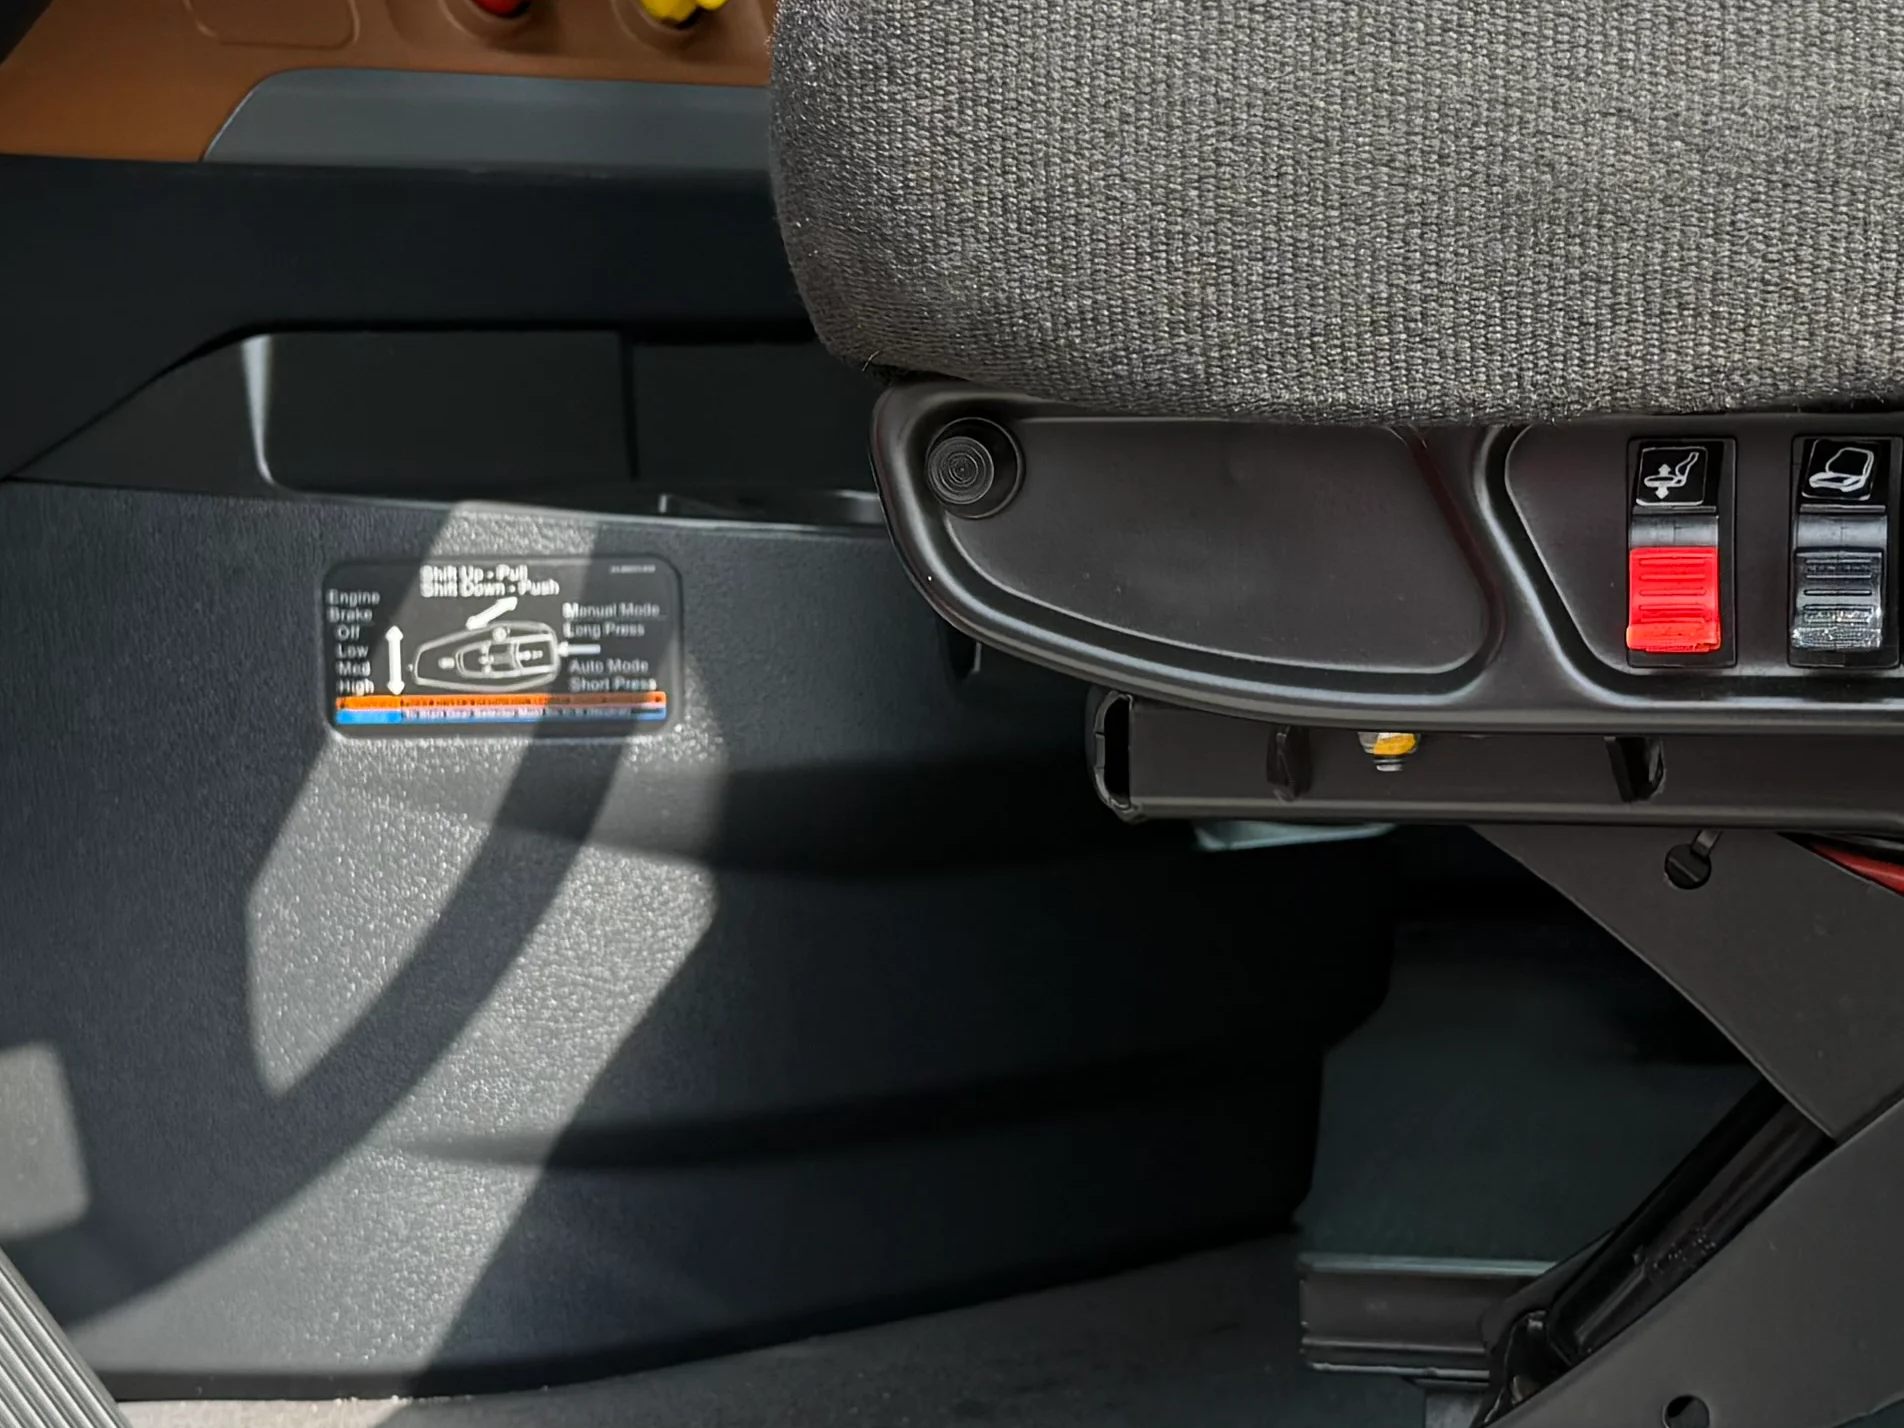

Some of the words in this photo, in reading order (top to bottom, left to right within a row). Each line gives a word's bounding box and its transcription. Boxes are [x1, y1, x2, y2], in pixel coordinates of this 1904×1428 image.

[419, 564, 458, 582] Shift
[460, 566, 484, 583] Up
[495, 564, 529, 581] Pull
[419, 581, 458, 598] Shift
[460, 581, 506, 597] Down
[517, 580, 560, 597] Push
[327, 589, 381, 607] Engine
[328, 607, 374, 623] Brake
[562, 602, 616, 620] Manual
[618, 603, 660, 619] Mode
[337, 625, 361, 641] Off
[563, 622, 602, 641] Long
[604, 622, 645, 638] Press
[336, 642, 369, 659] Low
[336, 660, 371, 677] Med
[569, 658, 606, 674] Auto
[608, 659, 650, 674] Mode
[336, 678, 375, 696] High
[569, 676, 611, 693] Short
[613, 676, 657, 693] Press
